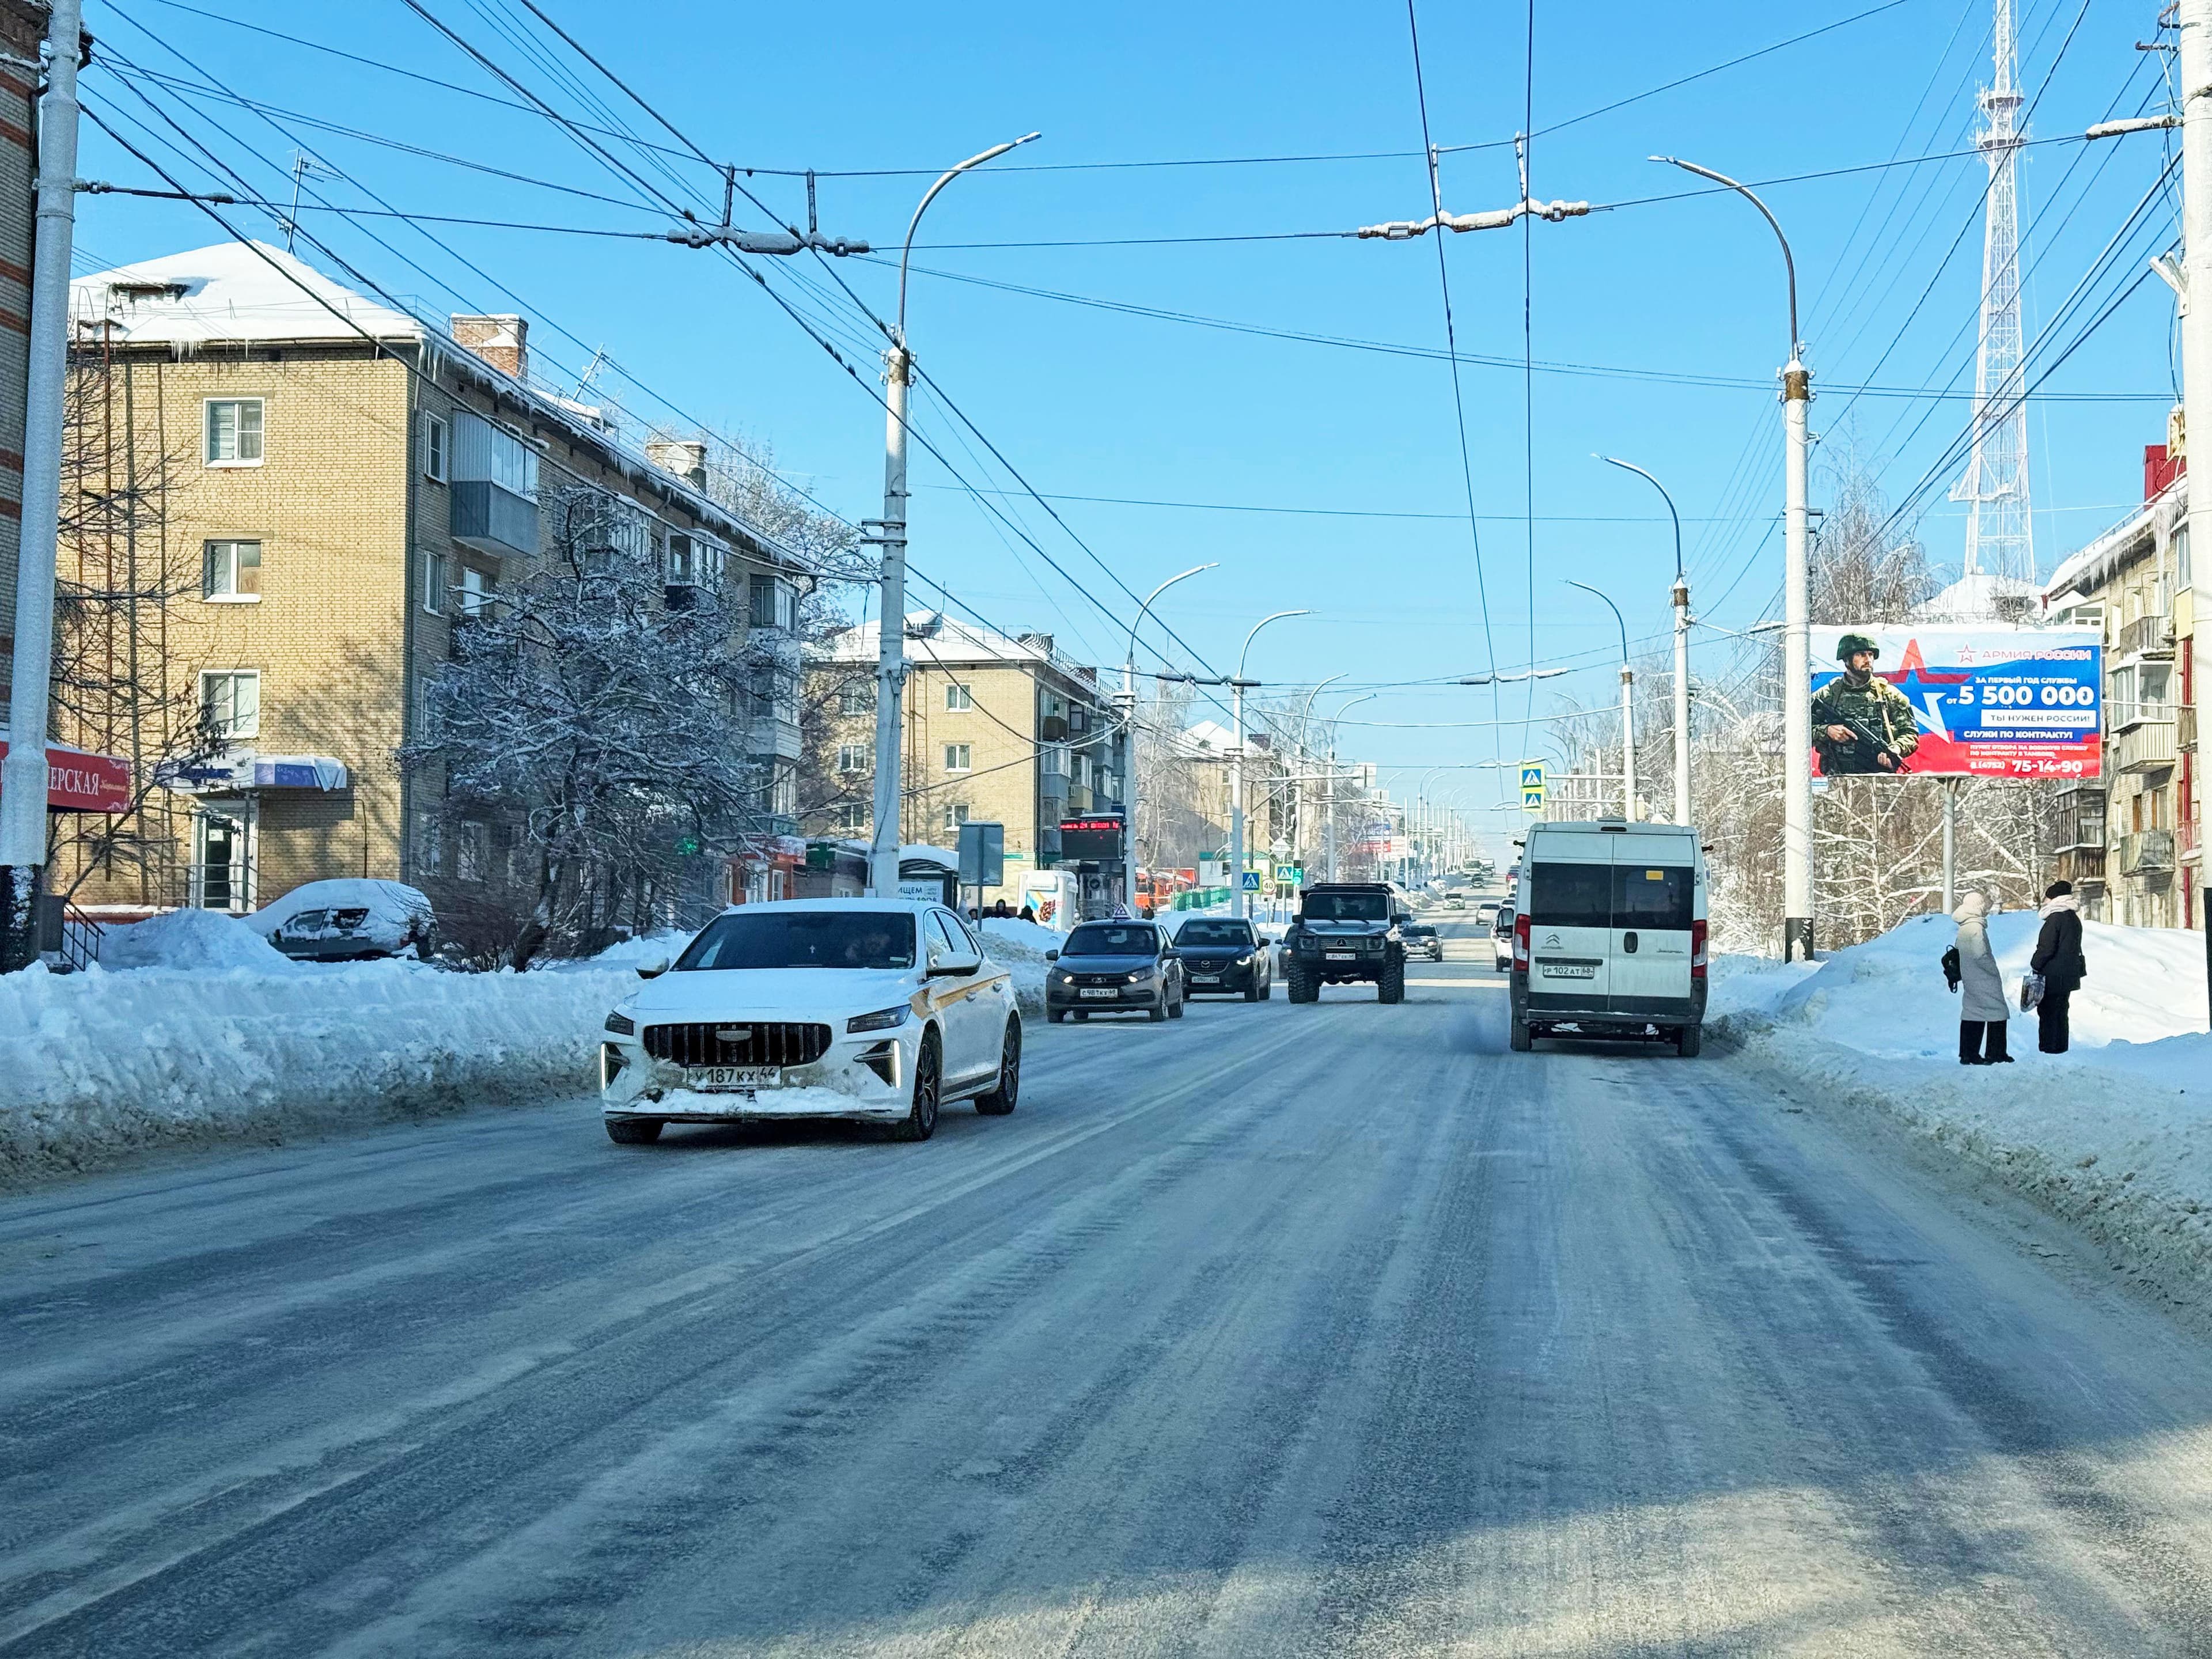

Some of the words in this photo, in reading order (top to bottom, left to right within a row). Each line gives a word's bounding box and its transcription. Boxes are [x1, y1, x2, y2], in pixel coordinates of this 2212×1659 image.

[1982, 650, 2032, 660] АРМИЯ
[2035, 650, 2091, 660] РОССИИ
[1988, 676, 2022, 684] ПЕРВЫЙ
[1959, 685, 1974, 704] 5
[1982, 685, 2033, 705] 500
[2041, 685, 2094, 706] 000
[1964, 730, 1998, 738] СЛУЖИ
[1999, 730, 2012, 738] ПО
[2016, 731, 2073, 739] КОНТРАКТУ!
[2012, 760, 2084, 773] 75-14-90
[48, 766, 100, 796] ЕРСКАЯ
